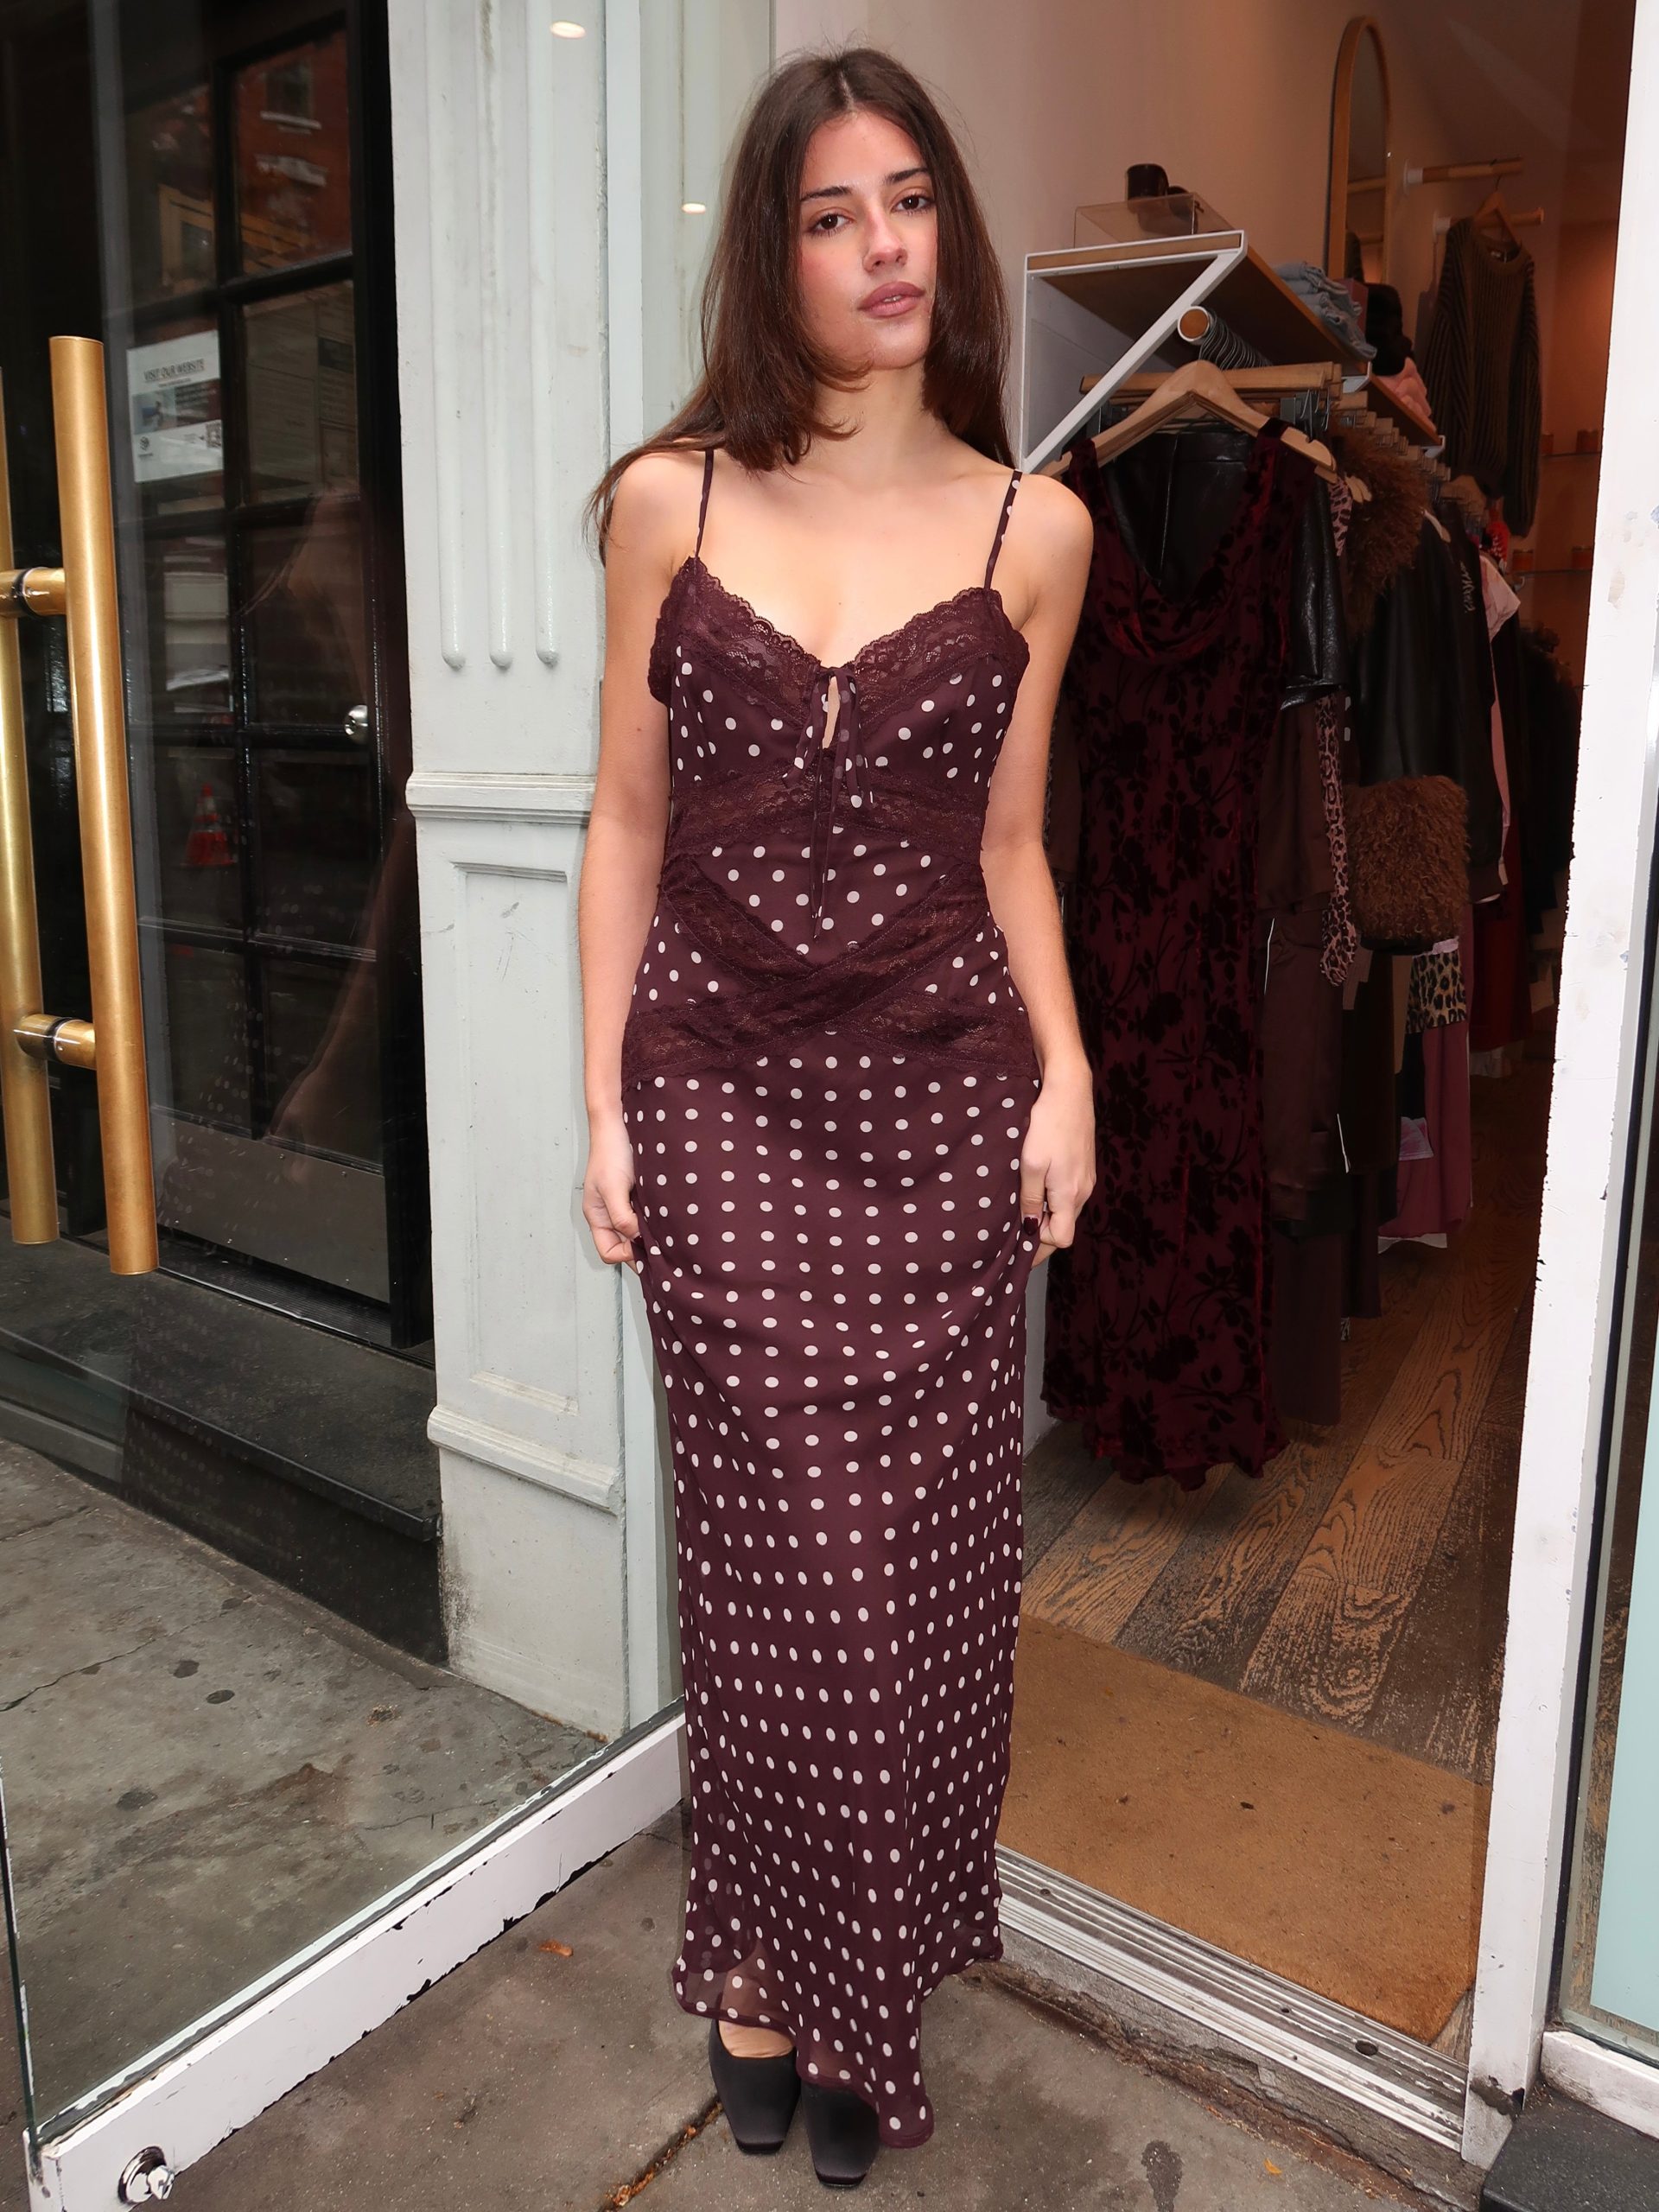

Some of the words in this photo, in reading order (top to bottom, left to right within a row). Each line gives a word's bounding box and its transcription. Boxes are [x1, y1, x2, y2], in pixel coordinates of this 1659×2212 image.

[144, 368, 161, 381] VISIT
[161, 365, 176, 378] OUR
[176, 359, 204, 374] WEBSITE
